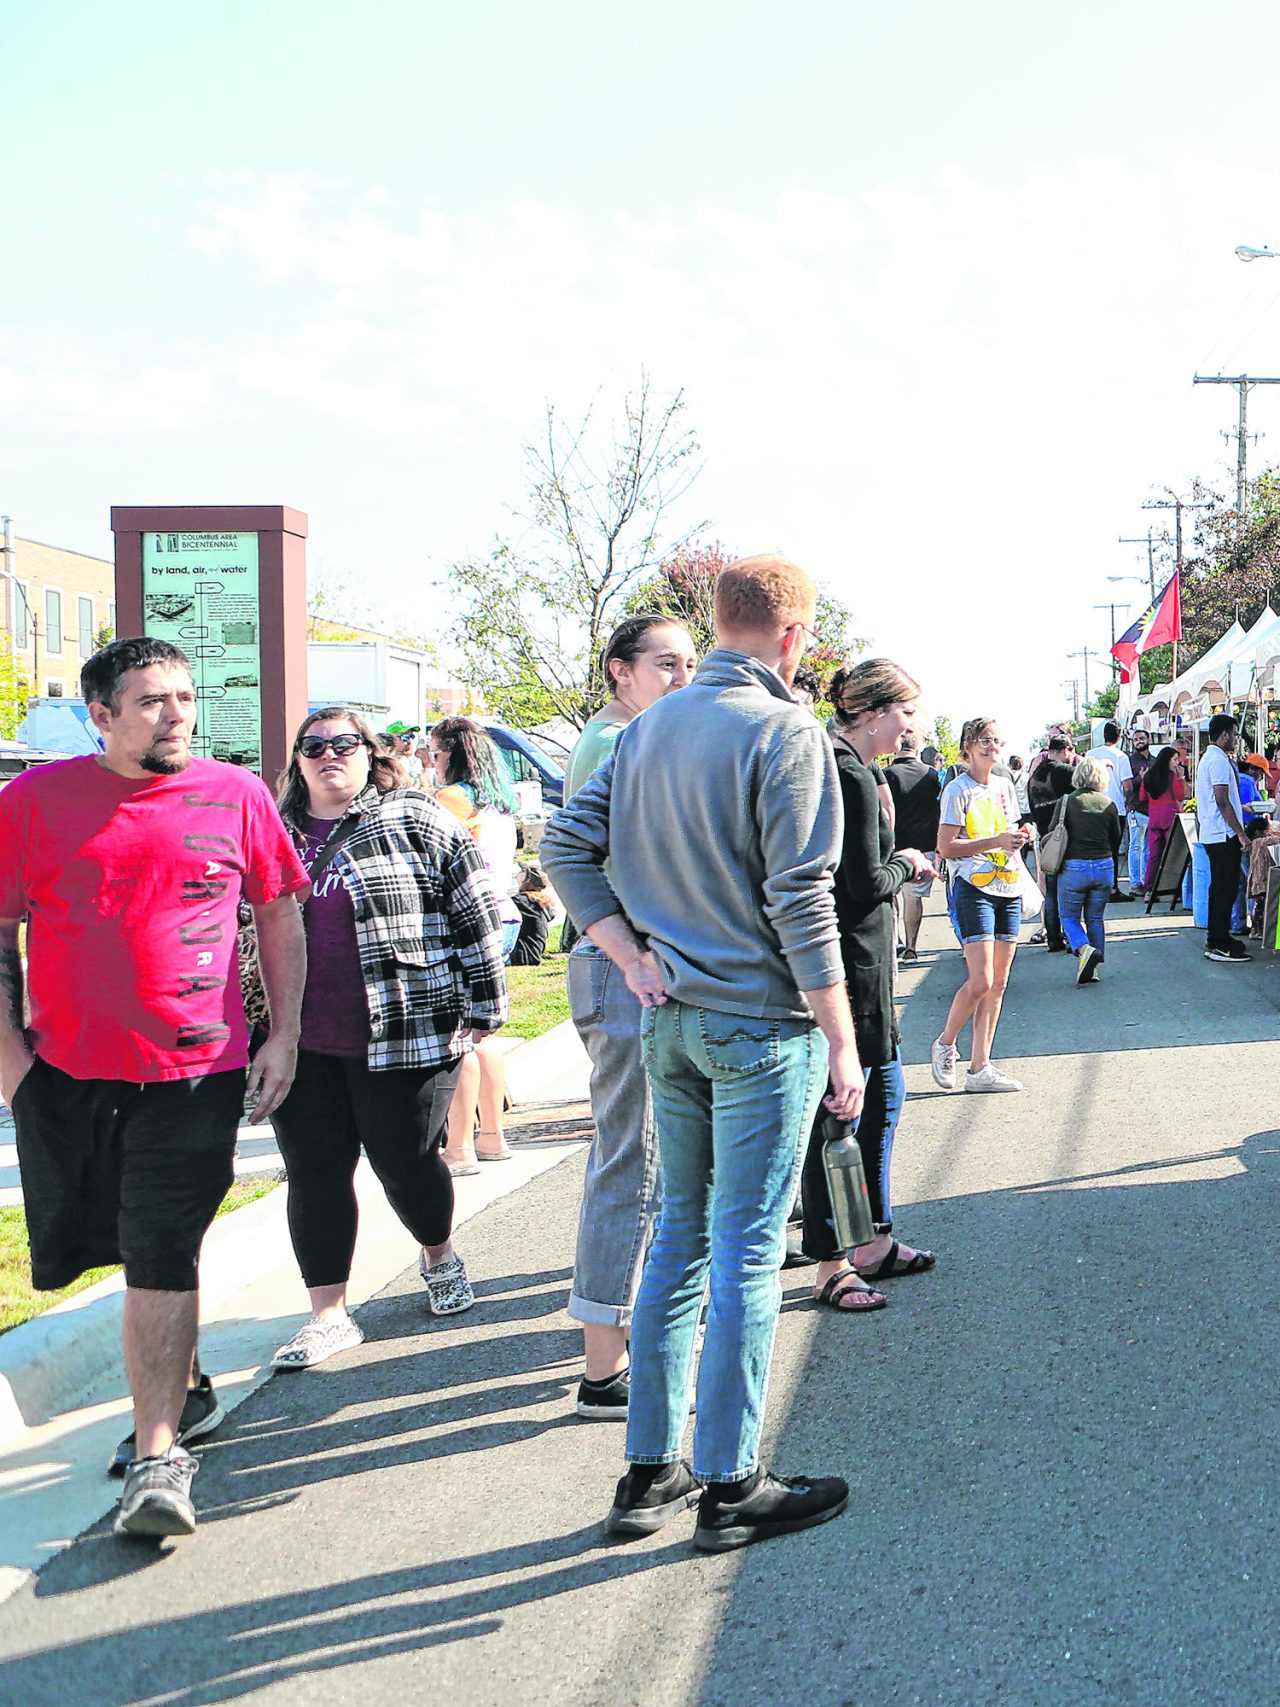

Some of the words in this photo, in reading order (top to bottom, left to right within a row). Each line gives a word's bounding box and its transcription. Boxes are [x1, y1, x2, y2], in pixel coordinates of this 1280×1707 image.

[152, 566, 164, 575] by
[166, 566, 190, 575] land,
[192, 566, 208, 574] air,
[176, 793, 240, 1047] JORDAN
